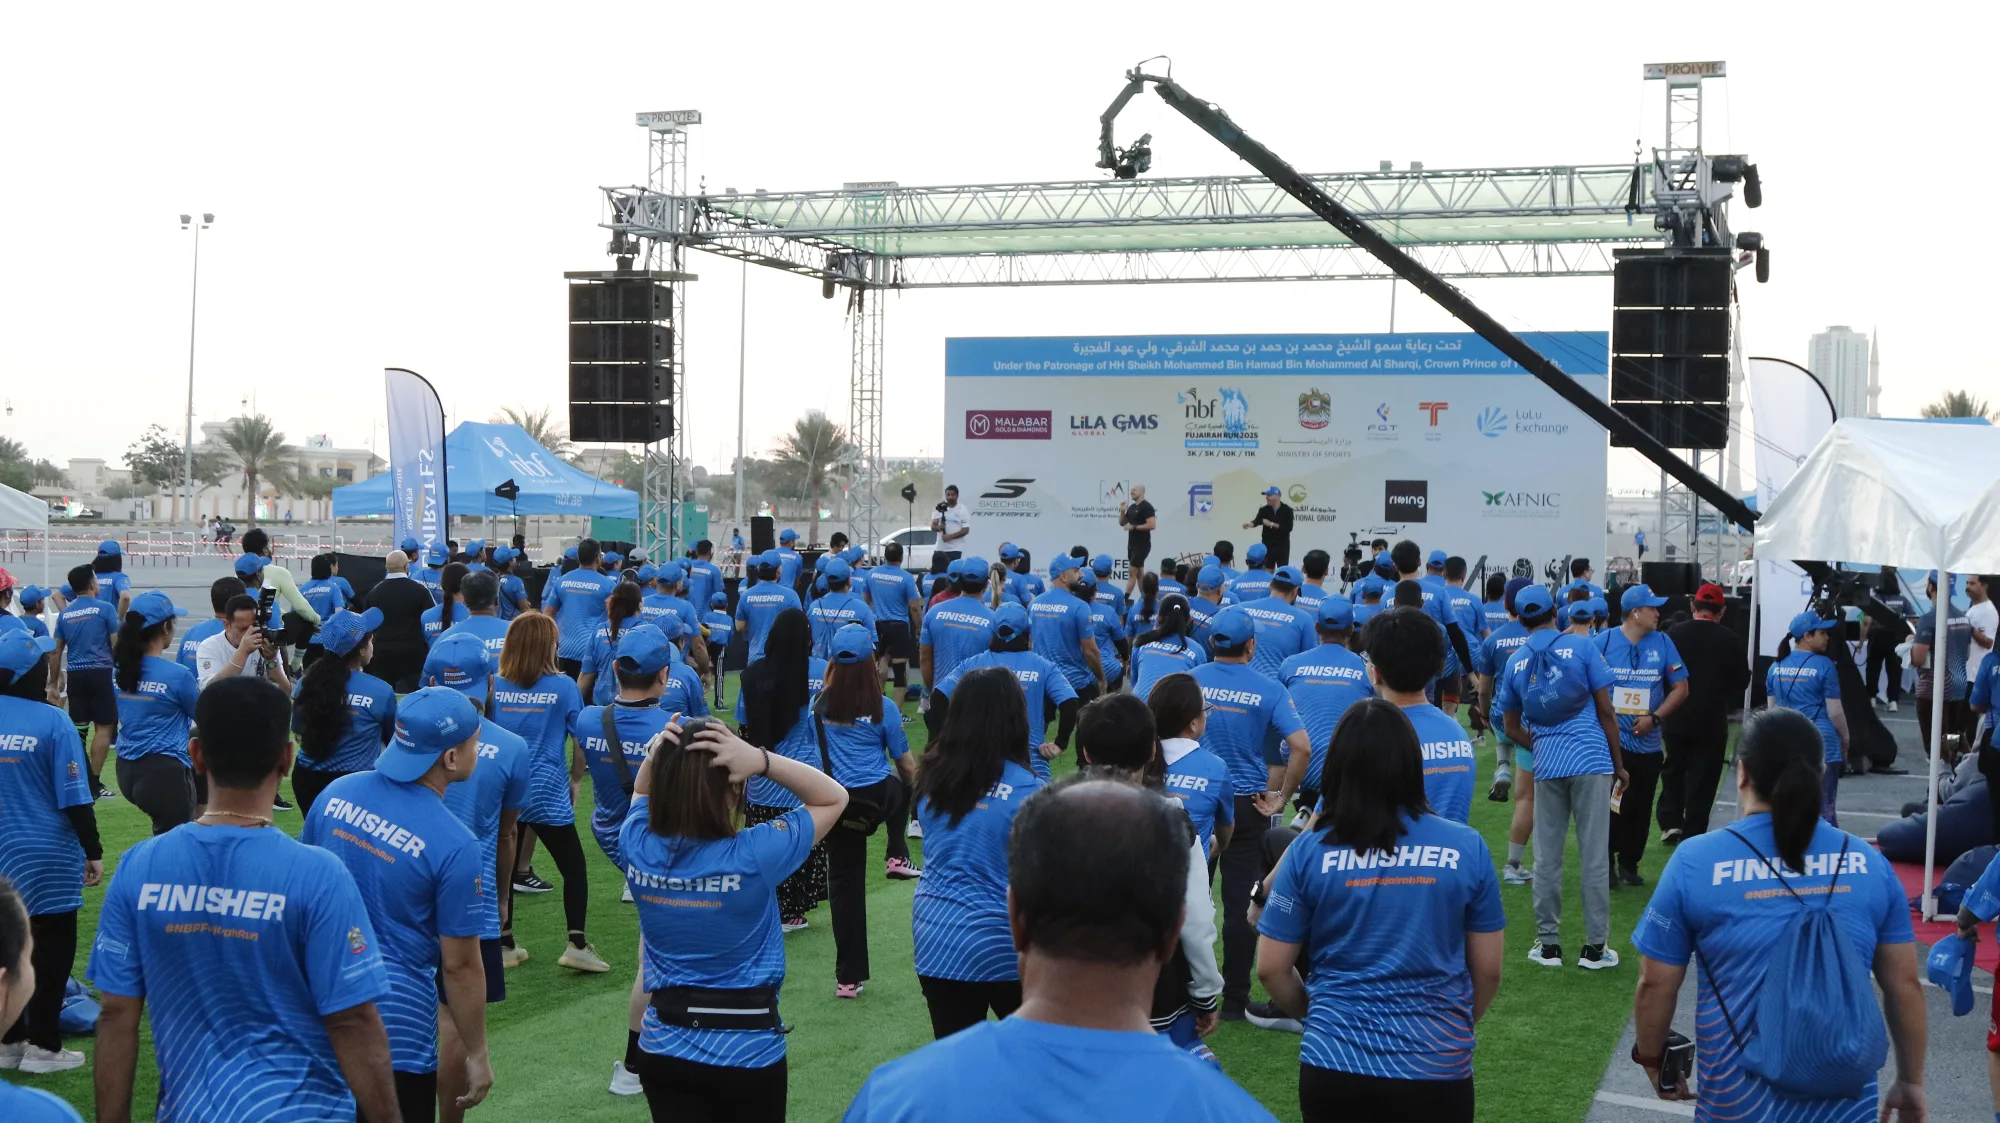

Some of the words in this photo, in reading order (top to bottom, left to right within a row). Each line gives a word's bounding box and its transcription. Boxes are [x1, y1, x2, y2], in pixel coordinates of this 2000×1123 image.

[1665, 63, 1718, 75] PROLYTE
[651, 111, 692, 123] PROLYTE
[1073, 341, 1111, 356] الفجيرة
[1113, 344, 1134, 356] عهد
[1136, 340, 1158, 358] ولي
[1210, 343, 1240, 352] محمد
[1242, 342, 1256, 355] بن
[1260, 343, 1282, 352] حمد
[1285, 342, 1299, 354] بن
[1302, 342, 1333, 351] محمد
[1336, 338, 1371, 356] الشيخ
[1374, 342, 1402, 353] سمو
[1405, 338, 1432, 353] رعاية
[1435, 339, 1462, 351] تحت
[993, 360, 1023, 371] Under
[1025, 360, 1041, 370] the
[1043, 360, 1094, 372] Patronage
[1097, 360, 1107, 370] of
[1109, 360, 1125, 370] HH
[1127, 360, 1161, 370] Sheikh
[1164, 360, 1223, 369] Mohammed
[1226, 360, 1244, 369] Bin
[1246, 360, 1283, 369] Hamad
[1286, 359, 1303, 369] Bin
[1305, 359, 1367, 369] Mohammed
[1370, 359, 1381, 369] Al
[1384, 359, 1422, 371] Sharqi,
[1424, 359, 1460, 369] Crown
[1462, 358, 1497, 369] Prince
[1500, 358, 1511, 369] of
[1185, 398, 1218, 418] nbf
[1515, 409, 1542, 420] LuLu
[995, 417, 1048, 427] MALABAR
[1070, 415, 1107, 430] LiLA
[1112, 414, 1159, 433] GMS
[1515, 423, 1569, 435] Exchange
[508, 452, 553, 477] nbf
[555, 492, 582, 506] nbf.ae
[978, 500, 1037, 509] SKECHERS
[1504, 492, 1561, 507] AFNIC
[1317, 514, 1337, 522] GROUP
[871, 572, 904, 583] FINISHER
[561, 580, 601, 591] FINISHER
[746, 594, 785, 603] FINISHER
[1296, 595, 1321, 606] INISH
[62, 607, 100, 620] FINISHER
[641, 605, 678, 616] INISHER
[812, 607, 856, 618] FINISHER
[1030, 603, 1069, 614] FINISHER
[935, 611, 990, 628] FINISHER
[1496, 636, 1529, 649] FINIS
[1296, 665, 1364, 681] FINISHER
[495, 691, 558, 704] FINISHER
[1200, 686, 1262, 707] NISHER
[1623, 692, 1641, 706] 75
[323, 797, 426, 859] FINISHER
[1321, 845, 1461, 874] FINISHER
[627, 863, 741, 893] FINISHER
[137, 883, 287, 921] FINISHER
